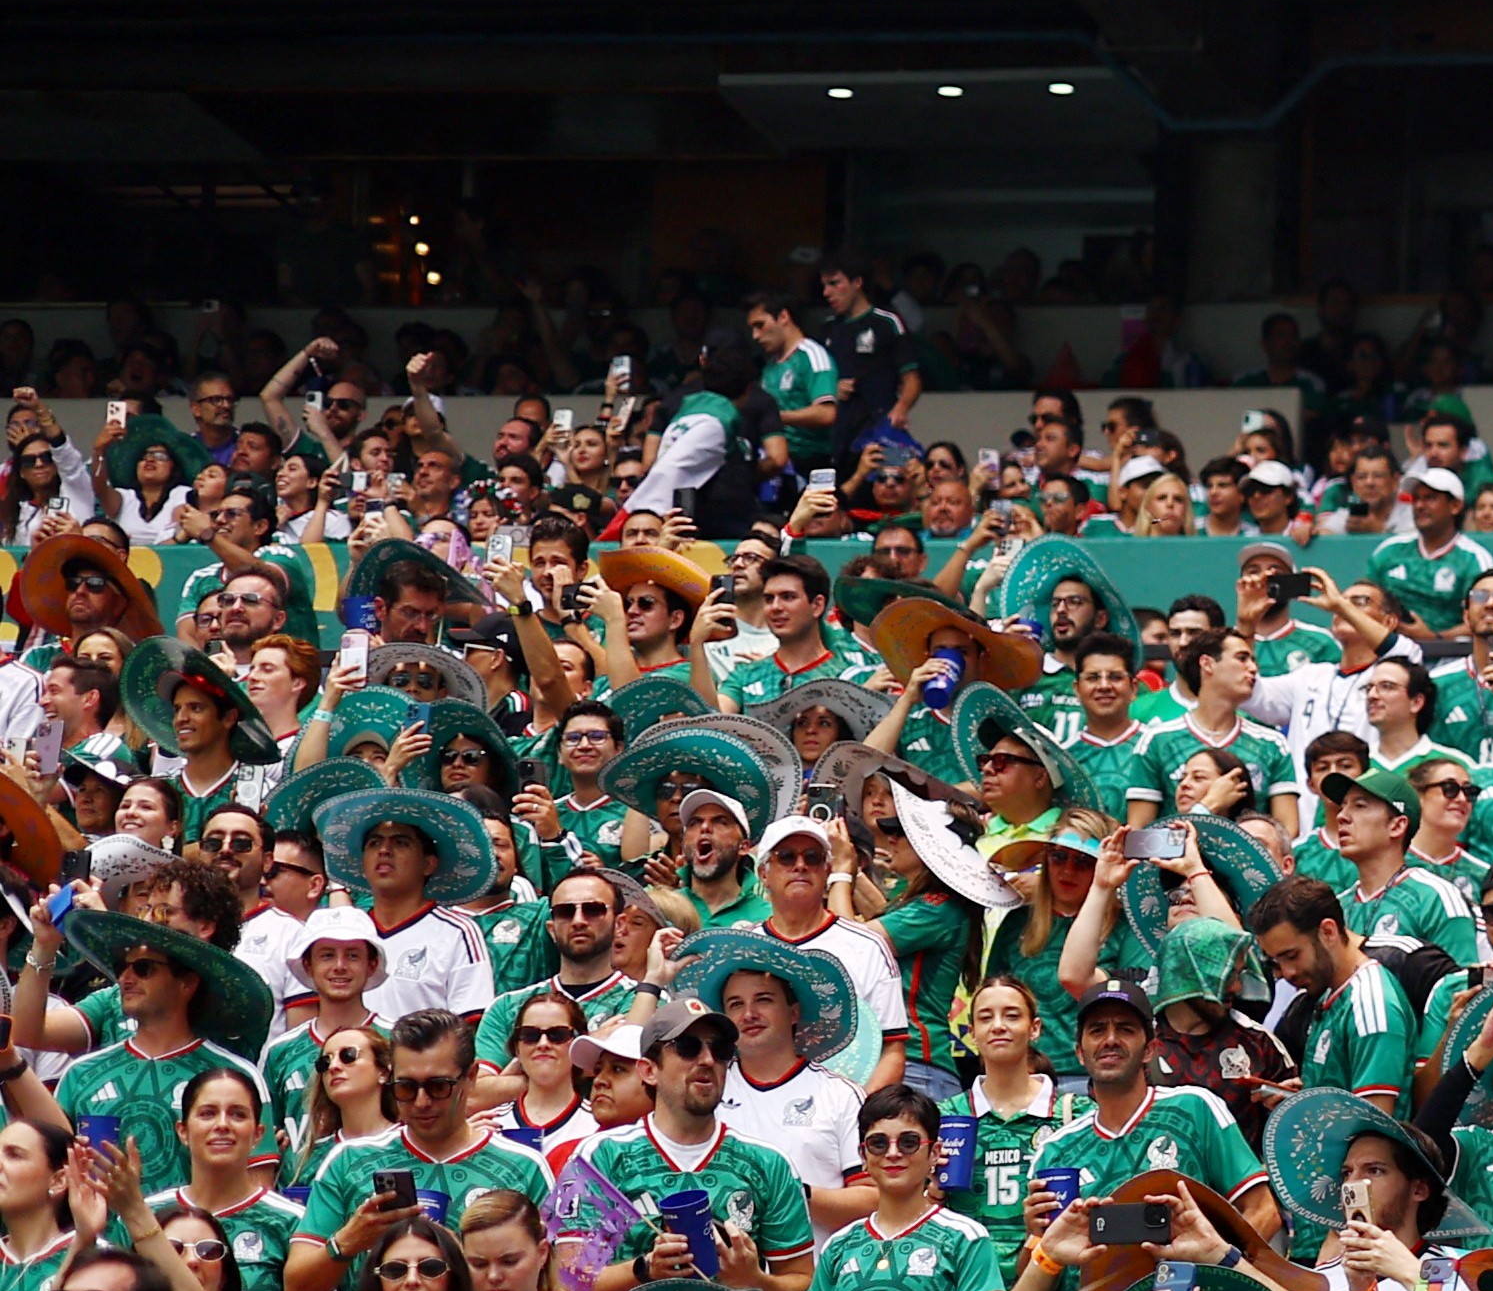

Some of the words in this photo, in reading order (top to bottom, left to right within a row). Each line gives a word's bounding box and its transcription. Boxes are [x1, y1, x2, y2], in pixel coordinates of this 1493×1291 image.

[985, 1149, 1021, 1165] MEXICO
[1265, 1144, 1275, 1166] FIFA
[984, 1165, 1021, 1206] 15
